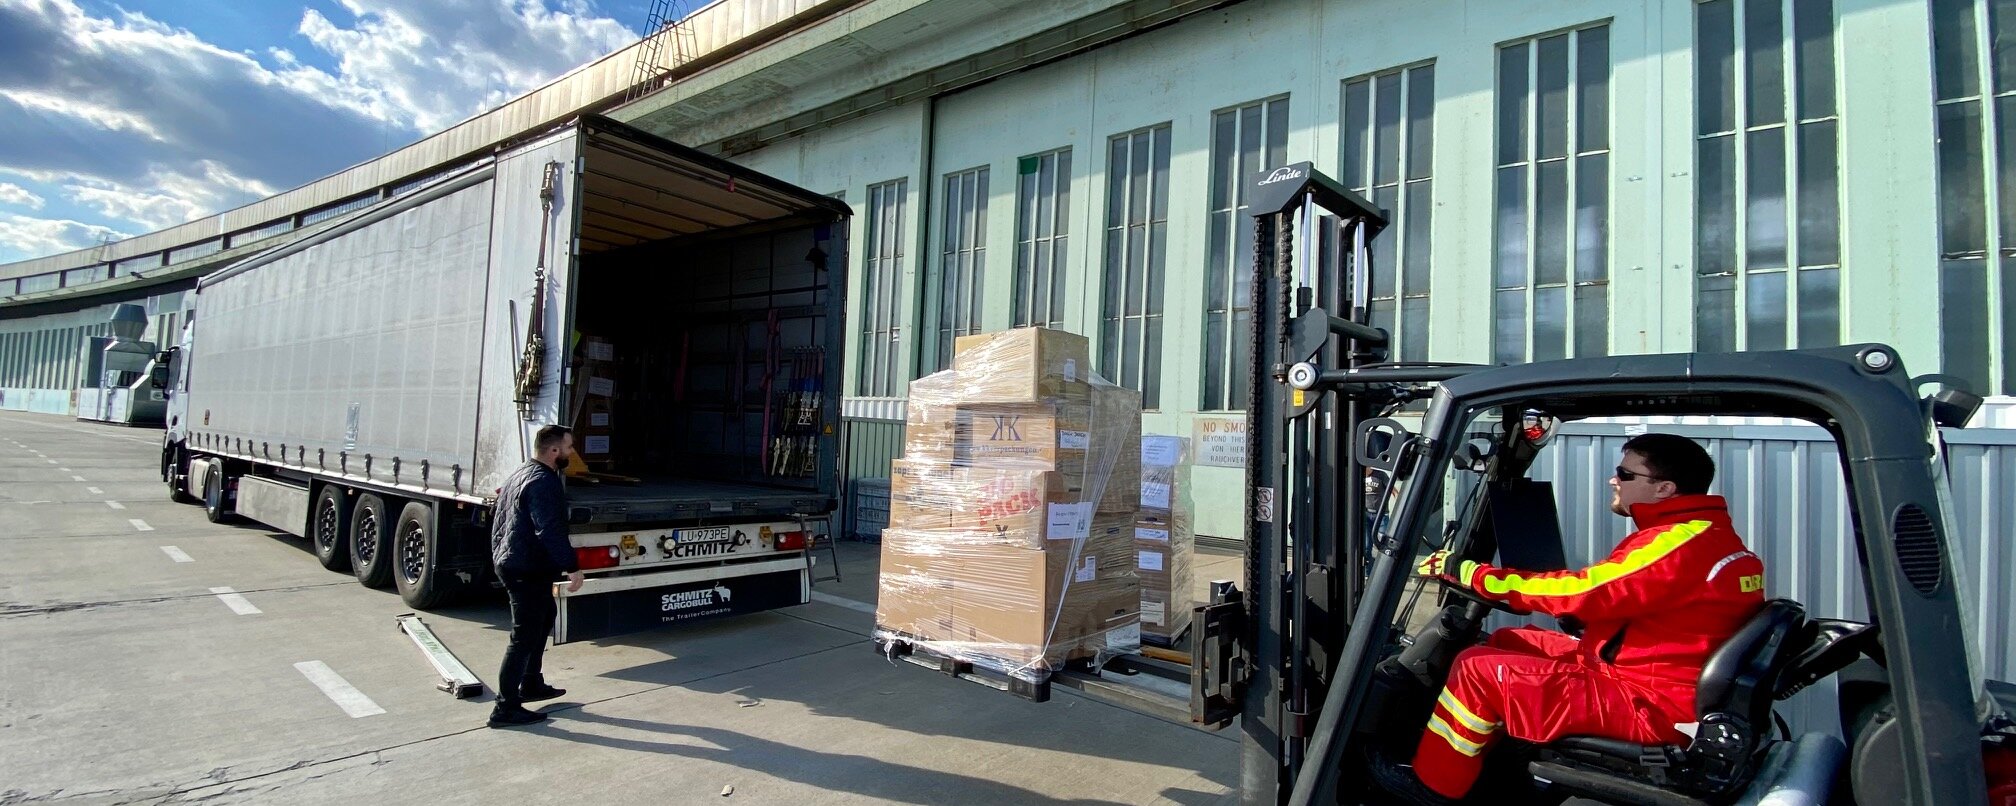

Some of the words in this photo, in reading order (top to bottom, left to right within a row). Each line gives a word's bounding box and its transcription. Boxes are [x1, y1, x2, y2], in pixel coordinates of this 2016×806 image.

[1258, 167, 1302, 185] Linde
[1204, 422, 1217, 432] NO
[681, 531, 693, 542] LU
[697, 528, 727, 540] 973PE
[663, 543, 736, 559] SCHMITZ
[1739, 575, 1763, 592] DR
[661, 588, 713, 604] SCHMITZ
[661, 598, 713, 612] CARGOBULL
